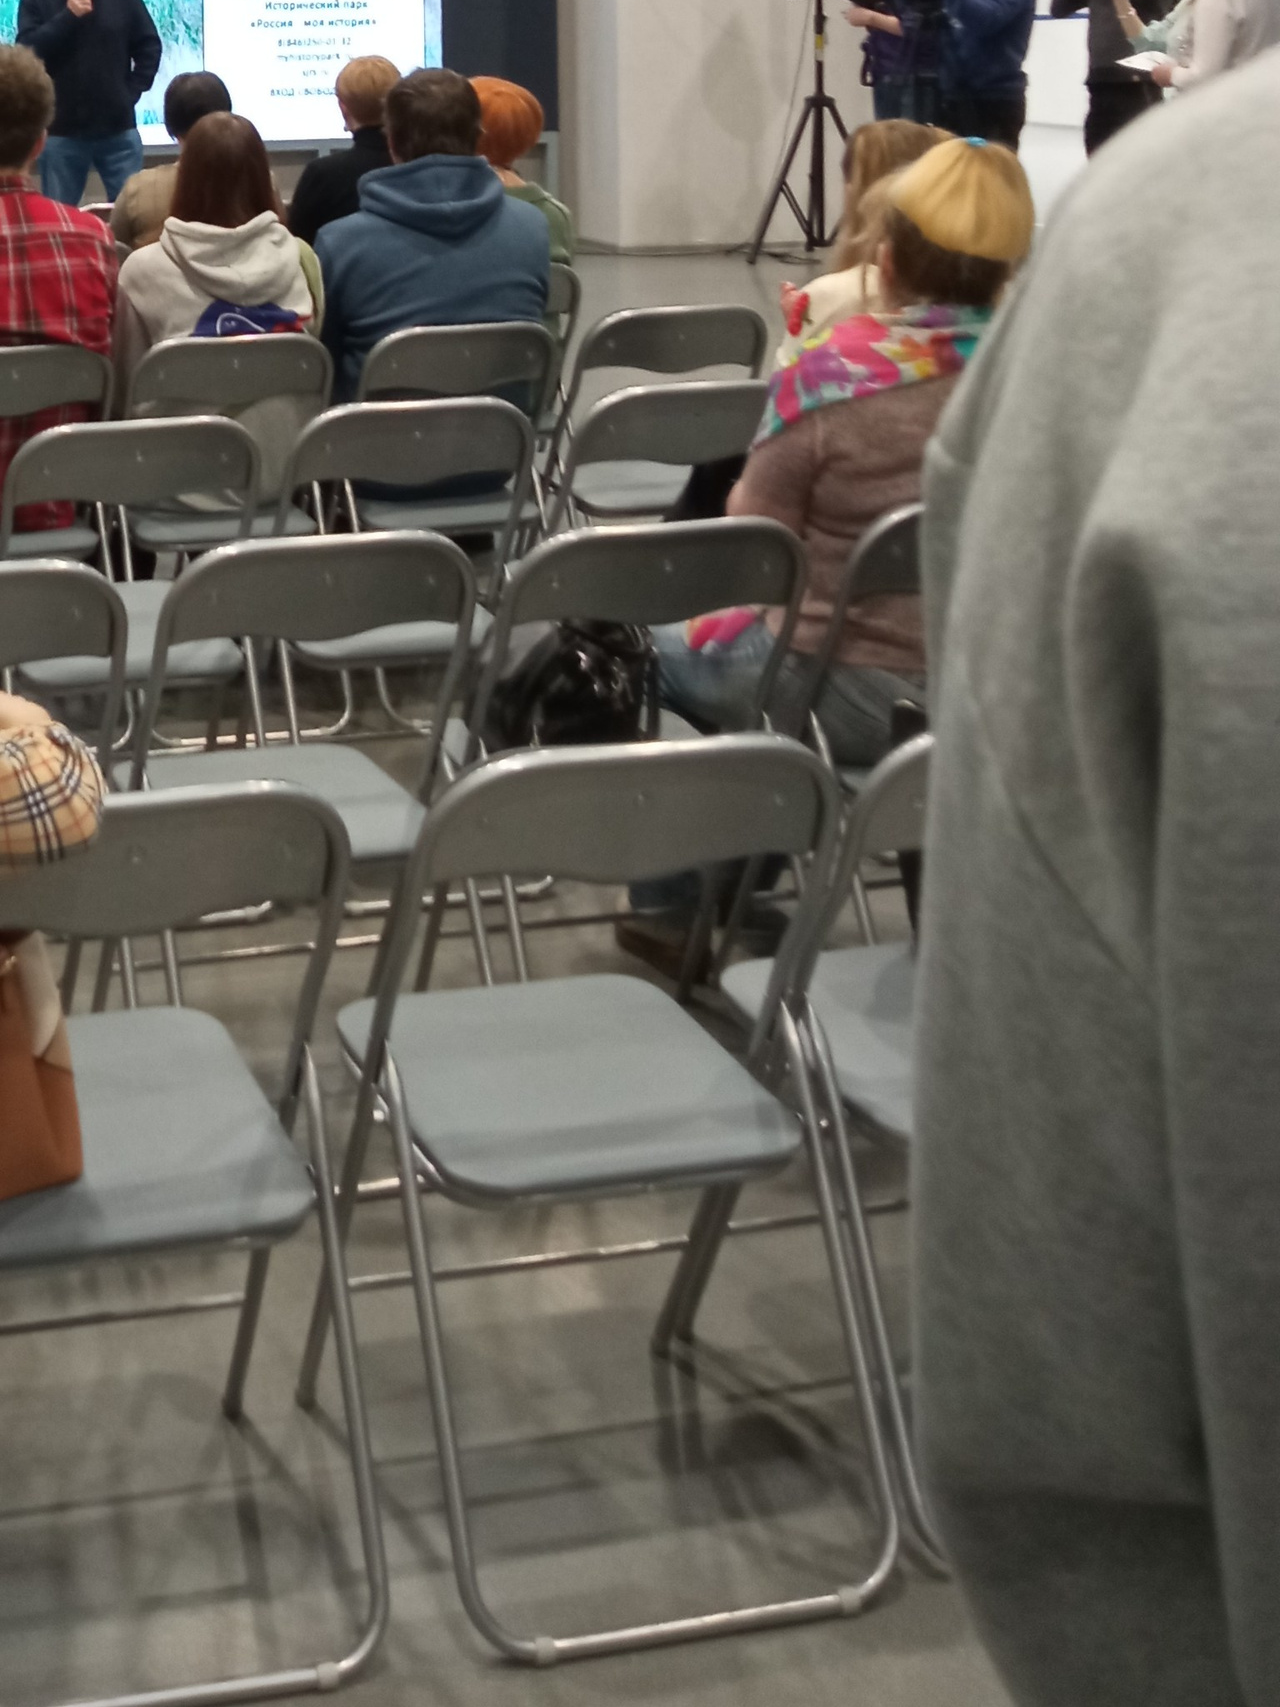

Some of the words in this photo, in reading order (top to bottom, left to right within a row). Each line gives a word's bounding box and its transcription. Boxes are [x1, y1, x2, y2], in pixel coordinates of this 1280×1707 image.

[265, 0, 340, 11] Исторический
[343, 1, 368, 10] парк
[304, 19, 324, 27] моя
